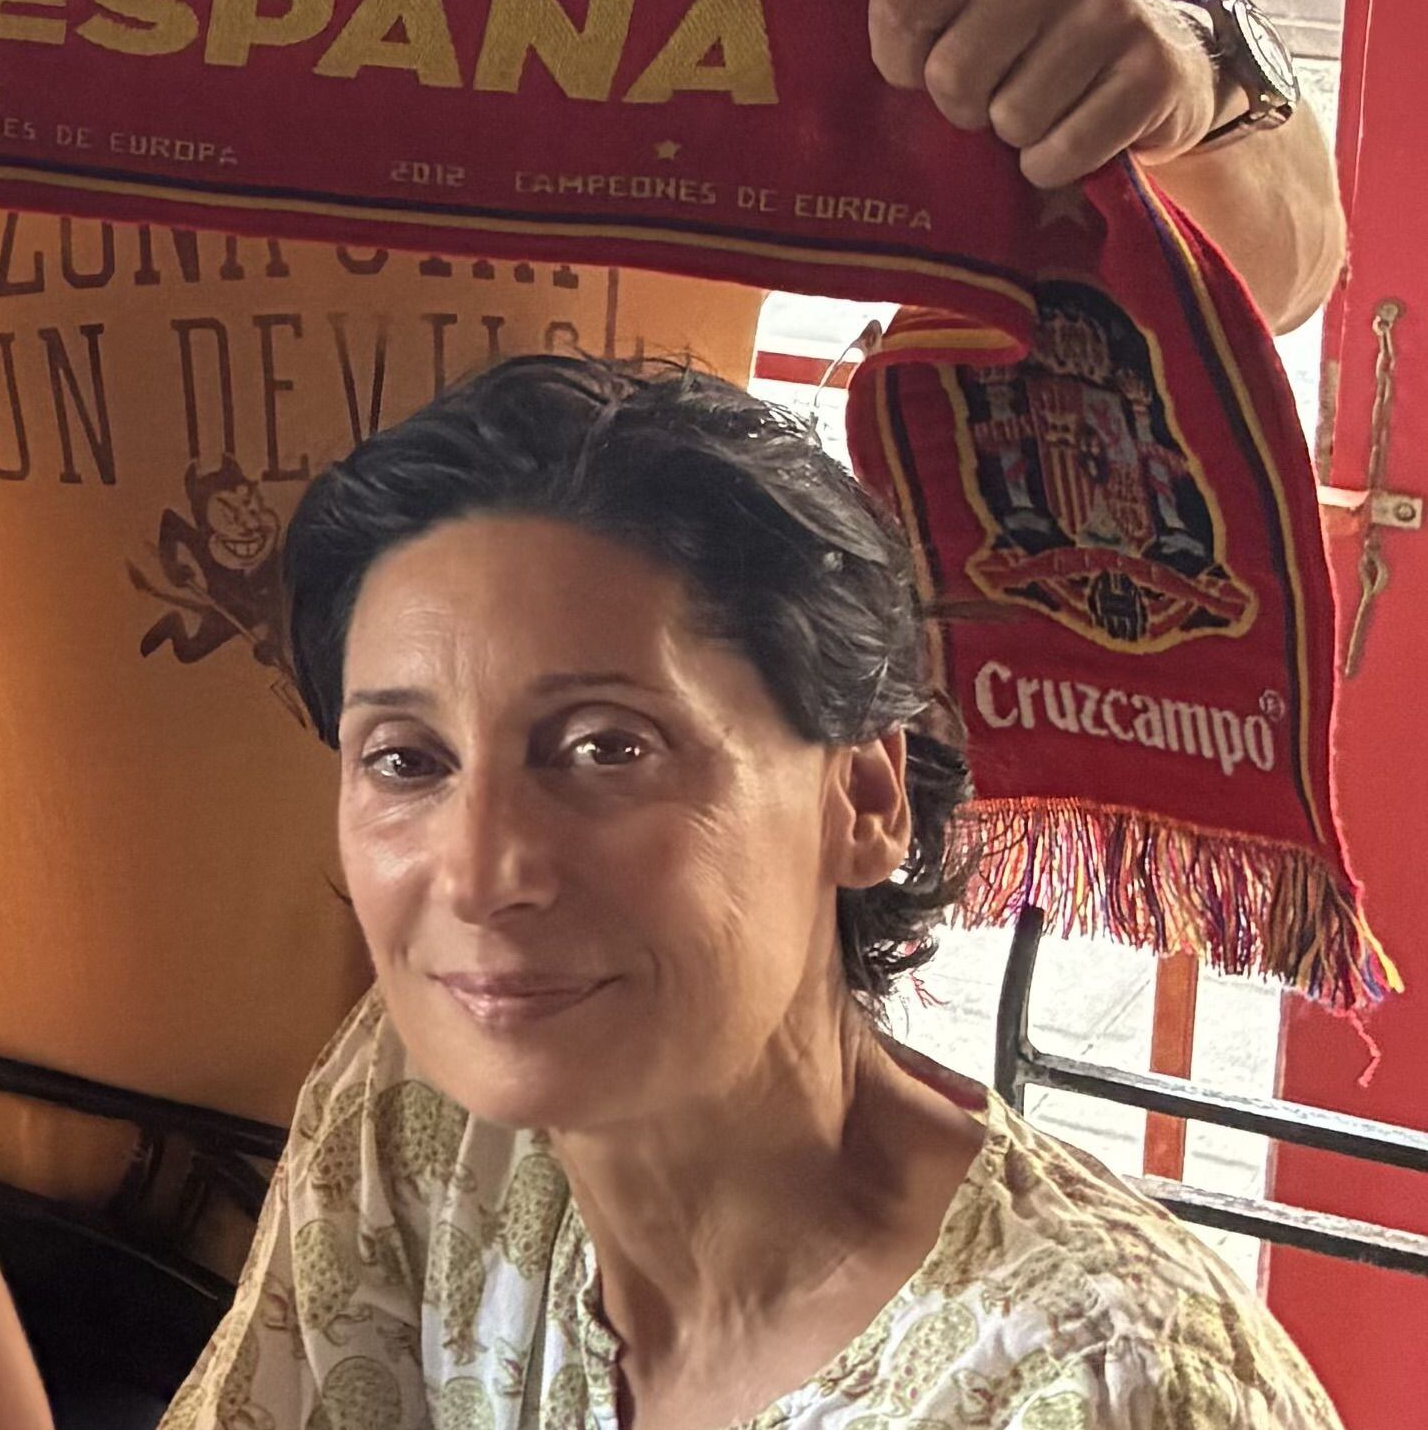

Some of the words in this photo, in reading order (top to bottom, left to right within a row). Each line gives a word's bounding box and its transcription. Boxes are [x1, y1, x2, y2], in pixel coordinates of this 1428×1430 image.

[56, 123, 93, 148] DE
[110, 131, 239, 166] EUROPA
[514, 170, 717, 206] CAMPEONES
[737, 185, 778, 214] DE
[794, 192, 933, 232] EUROPA
